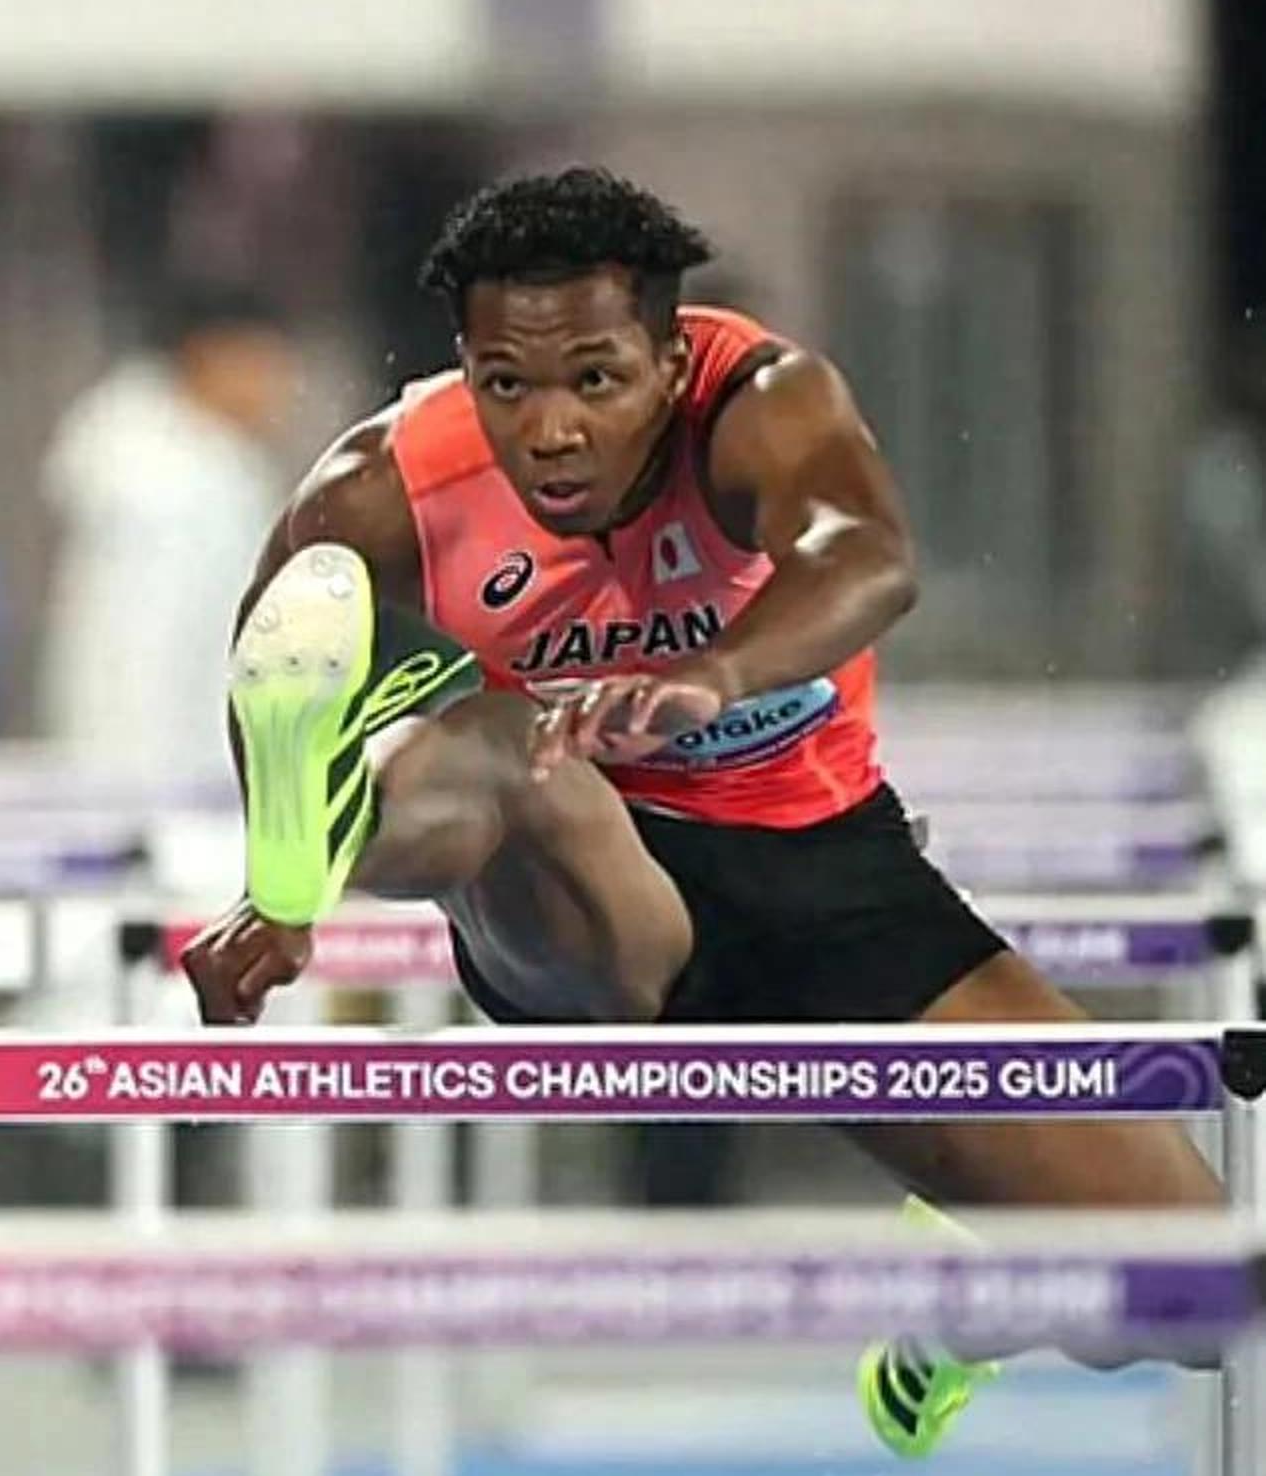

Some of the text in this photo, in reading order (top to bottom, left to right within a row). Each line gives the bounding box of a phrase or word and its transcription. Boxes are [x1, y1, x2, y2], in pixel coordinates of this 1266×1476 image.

[511, 604, 721, 671] JAPAN
[675, 699, 803, 749] atake
[107, 1061, 242, 1099] ASIAN
[252, 1061, 494, 1099] ATHLETICS
[505, 1060, 878, 1100] CHAMPIONSHIPS
[887, 1060, 990, 1099] 2025
[998, 1060, 1116, 1098] GUMI
